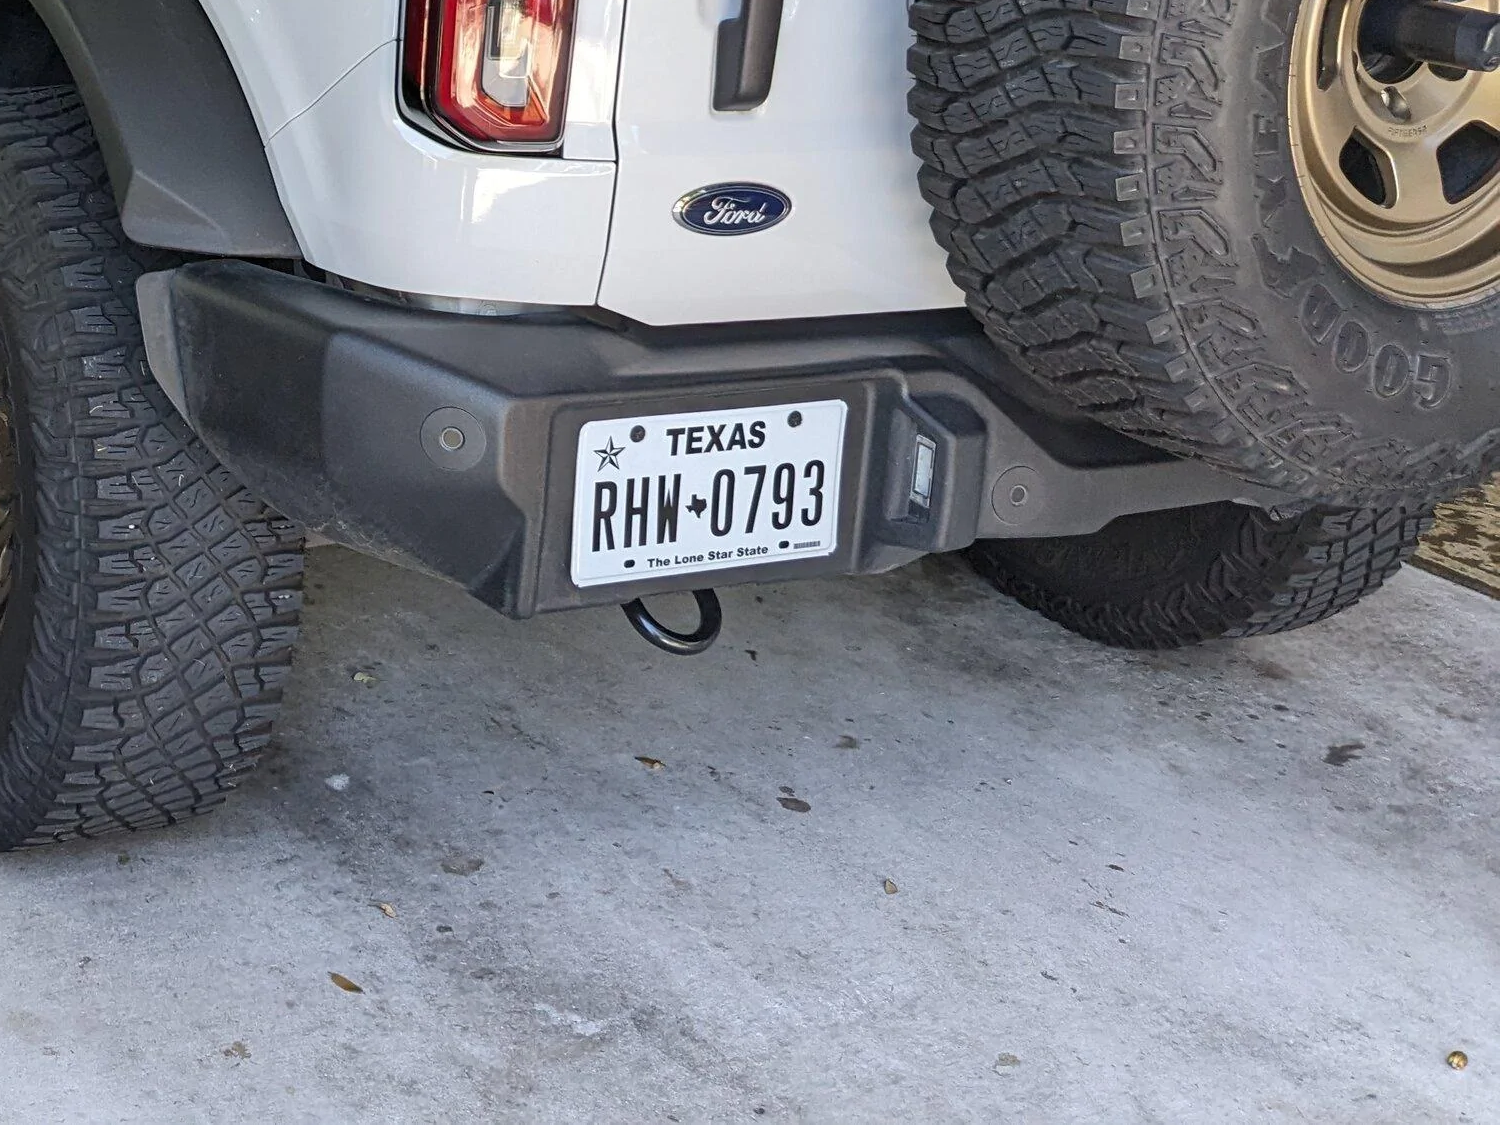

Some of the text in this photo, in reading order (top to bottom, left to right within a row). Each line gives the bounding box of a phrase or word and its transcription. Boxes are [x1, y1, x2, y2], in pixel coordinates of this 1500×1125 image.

[703, 195, 768, 225] Ford
[666, 420, 767, 457] TEXAS
[591, 459, 826, 553] RHW 0793
[647, 544, 769, 568] The Lone Star State
